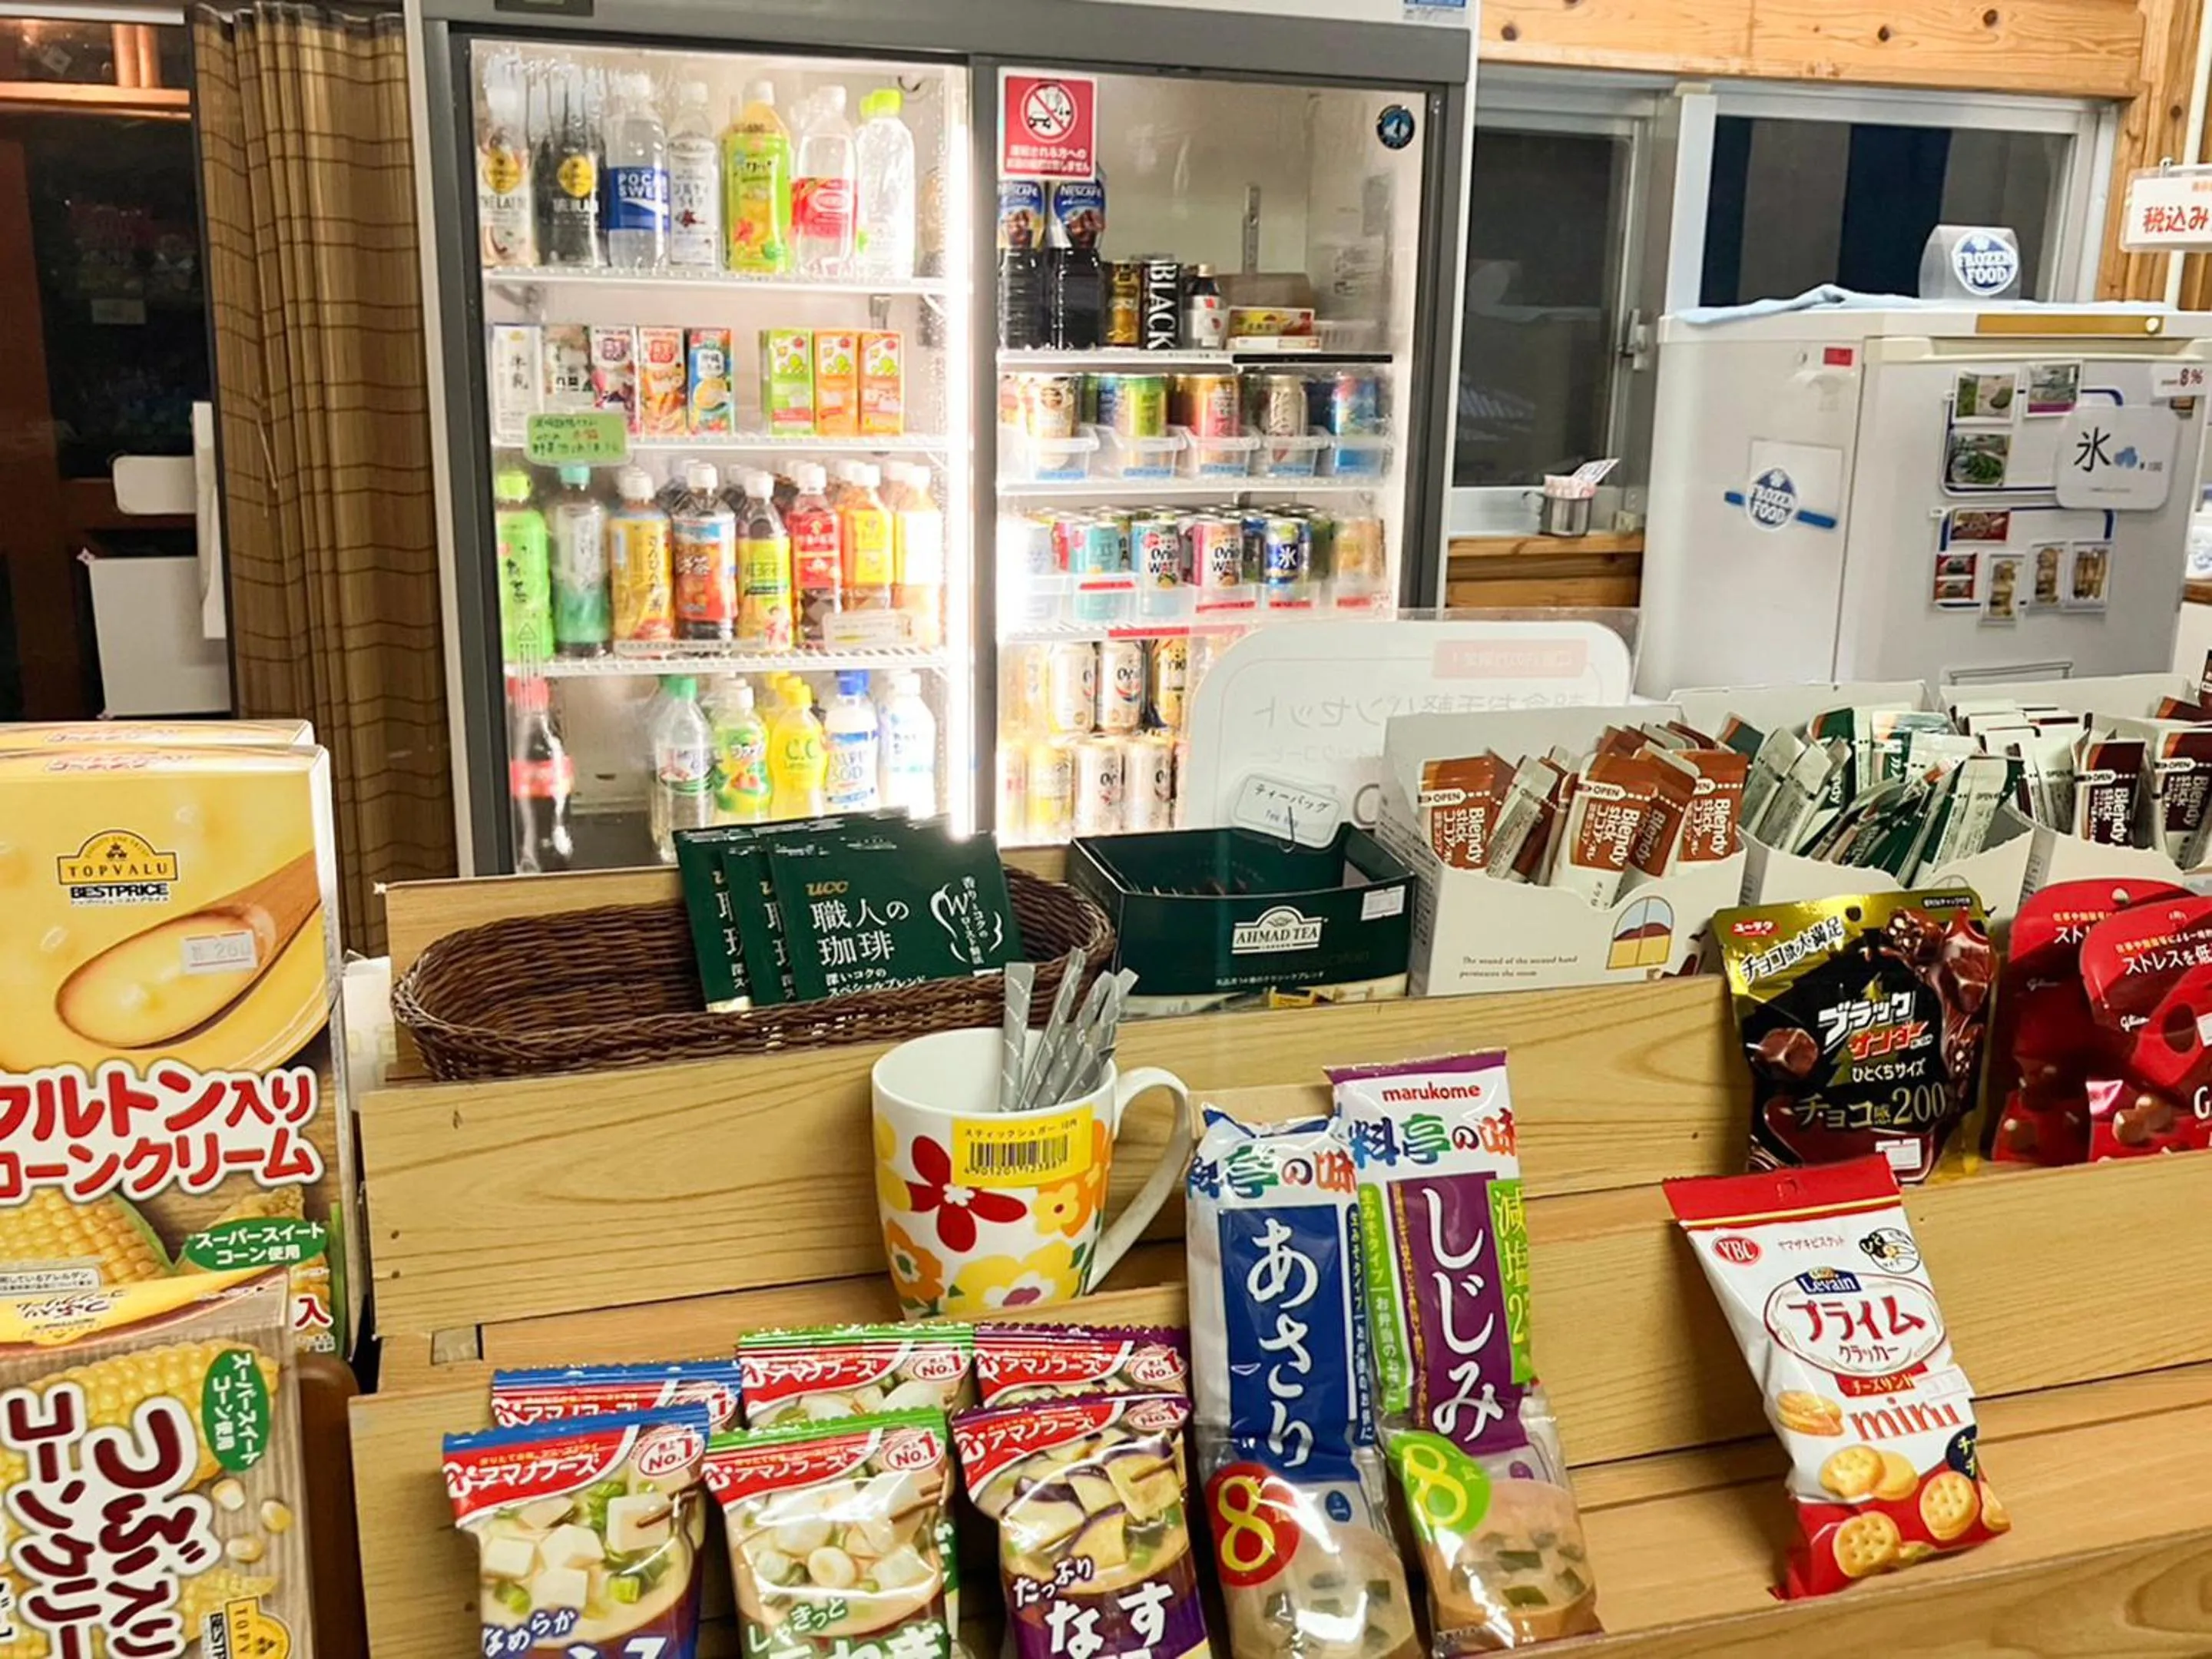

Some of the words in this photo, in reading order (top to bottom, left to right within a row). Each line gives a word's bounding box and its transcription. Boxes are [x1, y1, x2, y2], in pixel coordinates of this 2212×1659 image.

[1965, 266, 2008, 283] FOOD
[1146, 261, 1180, 350] BLACK
[2074, 426, 2111, 472] 氷
[1751, 502, 1786, 523] FOOD
[1432, 790, 1460, 803] OPEN
[1592, 784, 1621, 798] OPEN
[2183, 775, 2210, 827] Blendy
[1454, 808, 1469, 843] stick
[1601, 805, 1621, 843] stick
[1700, 798, 1715, 833] stick
[1709, 798, 1731, 856] Blendy
[2109, 787, 2130, 843] Blendy
[1465, 806, 1486, 864] Blendy
[1609, 808, 1641, 867] Blendy
[68, 863, 168, 877] TOPVALU
[70, 882, 169, 899] BESTPRICE
[810, 898, 910, 933] 職人の
[816, 930, 896, 967] 珈琲
[1236, 928, 1290, 945] AHMAD
[1292, 926, 1319, 941] TEA
[2054, 926, 2091, 945] スト
[1817, 991, 1916, 1054] ブラック
[1847, 1020, 1929, 1061] サンダー
[1851, 1057, 1927, 1084] ひとくちサイズ
[1382, 1081, 1481, 1103] marukome
[1348, 1107, 1518, 1169] 料亭の味
[194, 1221, 325, 1249] スーパースイート
[1716, 1237, 1757, 1263] YBC
[216, 1245, 300, 1264] コーン使用
[1799, 1274, 1857, 1293] Levain
[1421, 1187, 1506, 1442] しじみ
[1786, 1296, 1927, 1342] プライム
[1246, 1217, 1320, 1469] あさり
[1839, 1343, 1899, 1363] クラッカー
[1001, 1356, 1102, 1375] アマノフーズ
[212, 1376, 235, 1452] コーン使用
[232, 1353, 260, 1465] スーパースイート
[1848, 1396, 1963, 1442] mini
[988, 1416, 1096, 1451] アマノフーズ
[478, 1452, 601, 1491] アマノフーズ
[733, 1447, 863, 1483] アマノフーズ
[1402, 1443, 1468, 1526] 8
[94, 1408, 207, 1657] つぶ入り
[1217, 1475, 1275, 1572] 8
[1014, 1559, 1094, 1608] たっぷり
[482, 1610, 579, 1657] なめらか
[748, 1598, 846, 1654] しゃきっと
